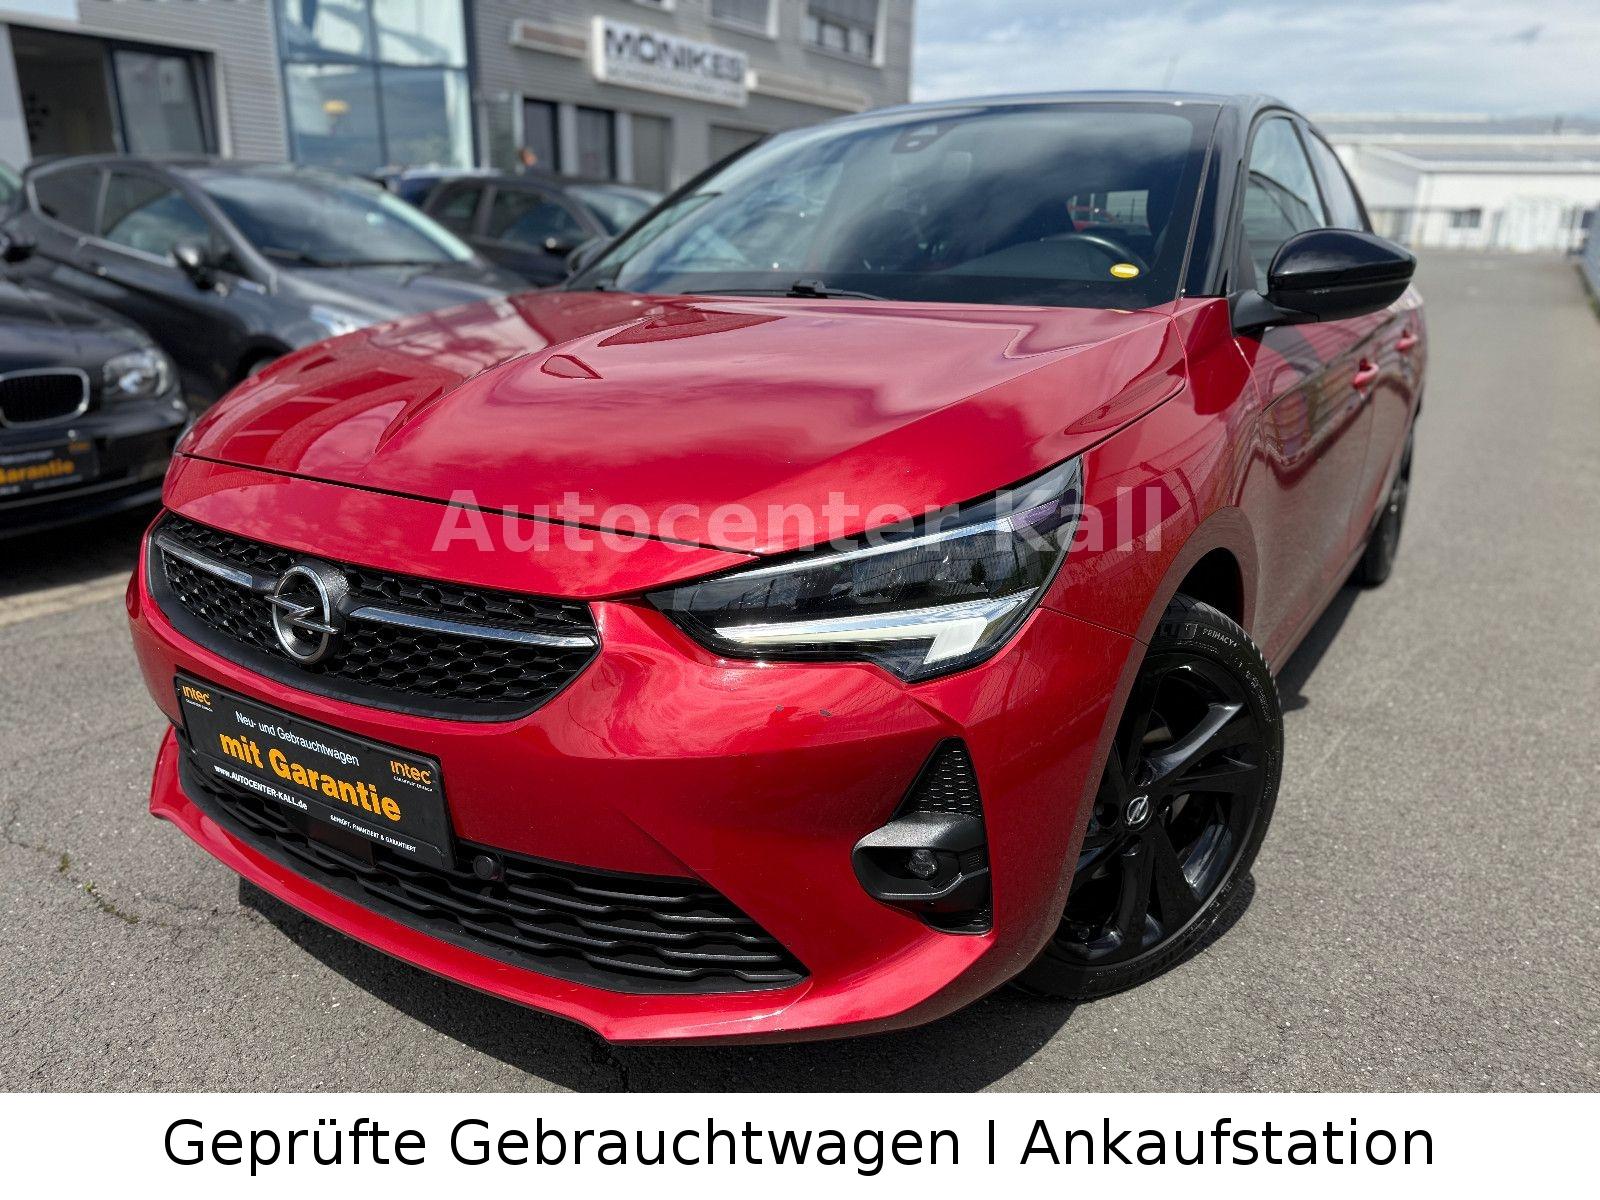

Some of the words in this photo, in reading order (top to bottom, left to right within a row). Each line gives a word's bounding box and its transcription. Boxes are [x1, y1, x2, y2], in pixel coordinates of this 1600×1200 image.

[182, 686, 211, 705] intec
[235, 710, 257, 728] Neu-
[259, 723, 276, 736] und
[277, 727, 360, 767] Gebrauchtwagen
[213, 764, 308, 811] www.AUTOCENTER-KALL.de
[219, 733, 264, 769] mit
[268, 748, 401, 821] Garantie
[390, 760, 431, 785] intec
[385, 837, 417, 853] GARANTIERT
